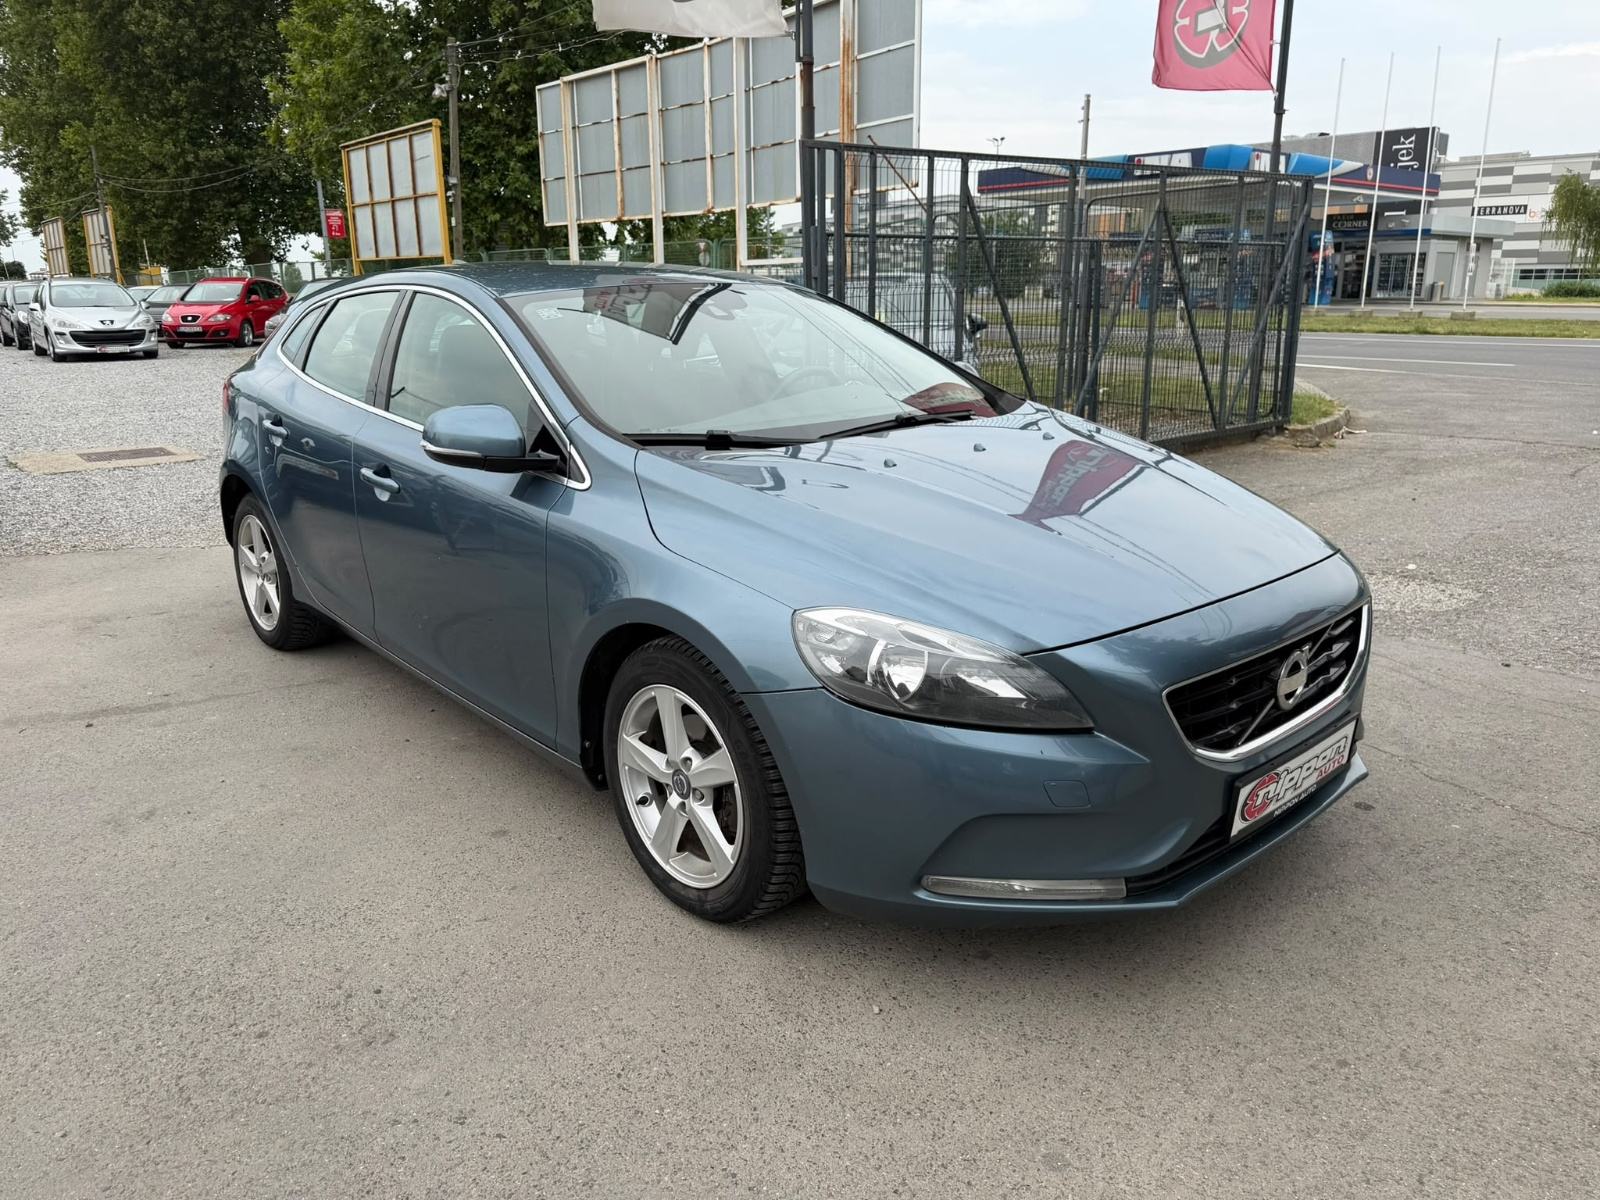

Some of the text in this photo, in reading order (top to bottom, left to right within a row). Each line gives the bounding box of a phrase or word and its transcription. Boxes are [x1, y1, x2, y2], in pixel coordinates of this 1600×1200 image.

[1332, 220, 1368, 228] CORNER
[1252, 736, 1348, 808] nippon
[1316, 754, 1345, 781] AUTO
[1273, 784, 1317, 817] NIPPON AUTO
